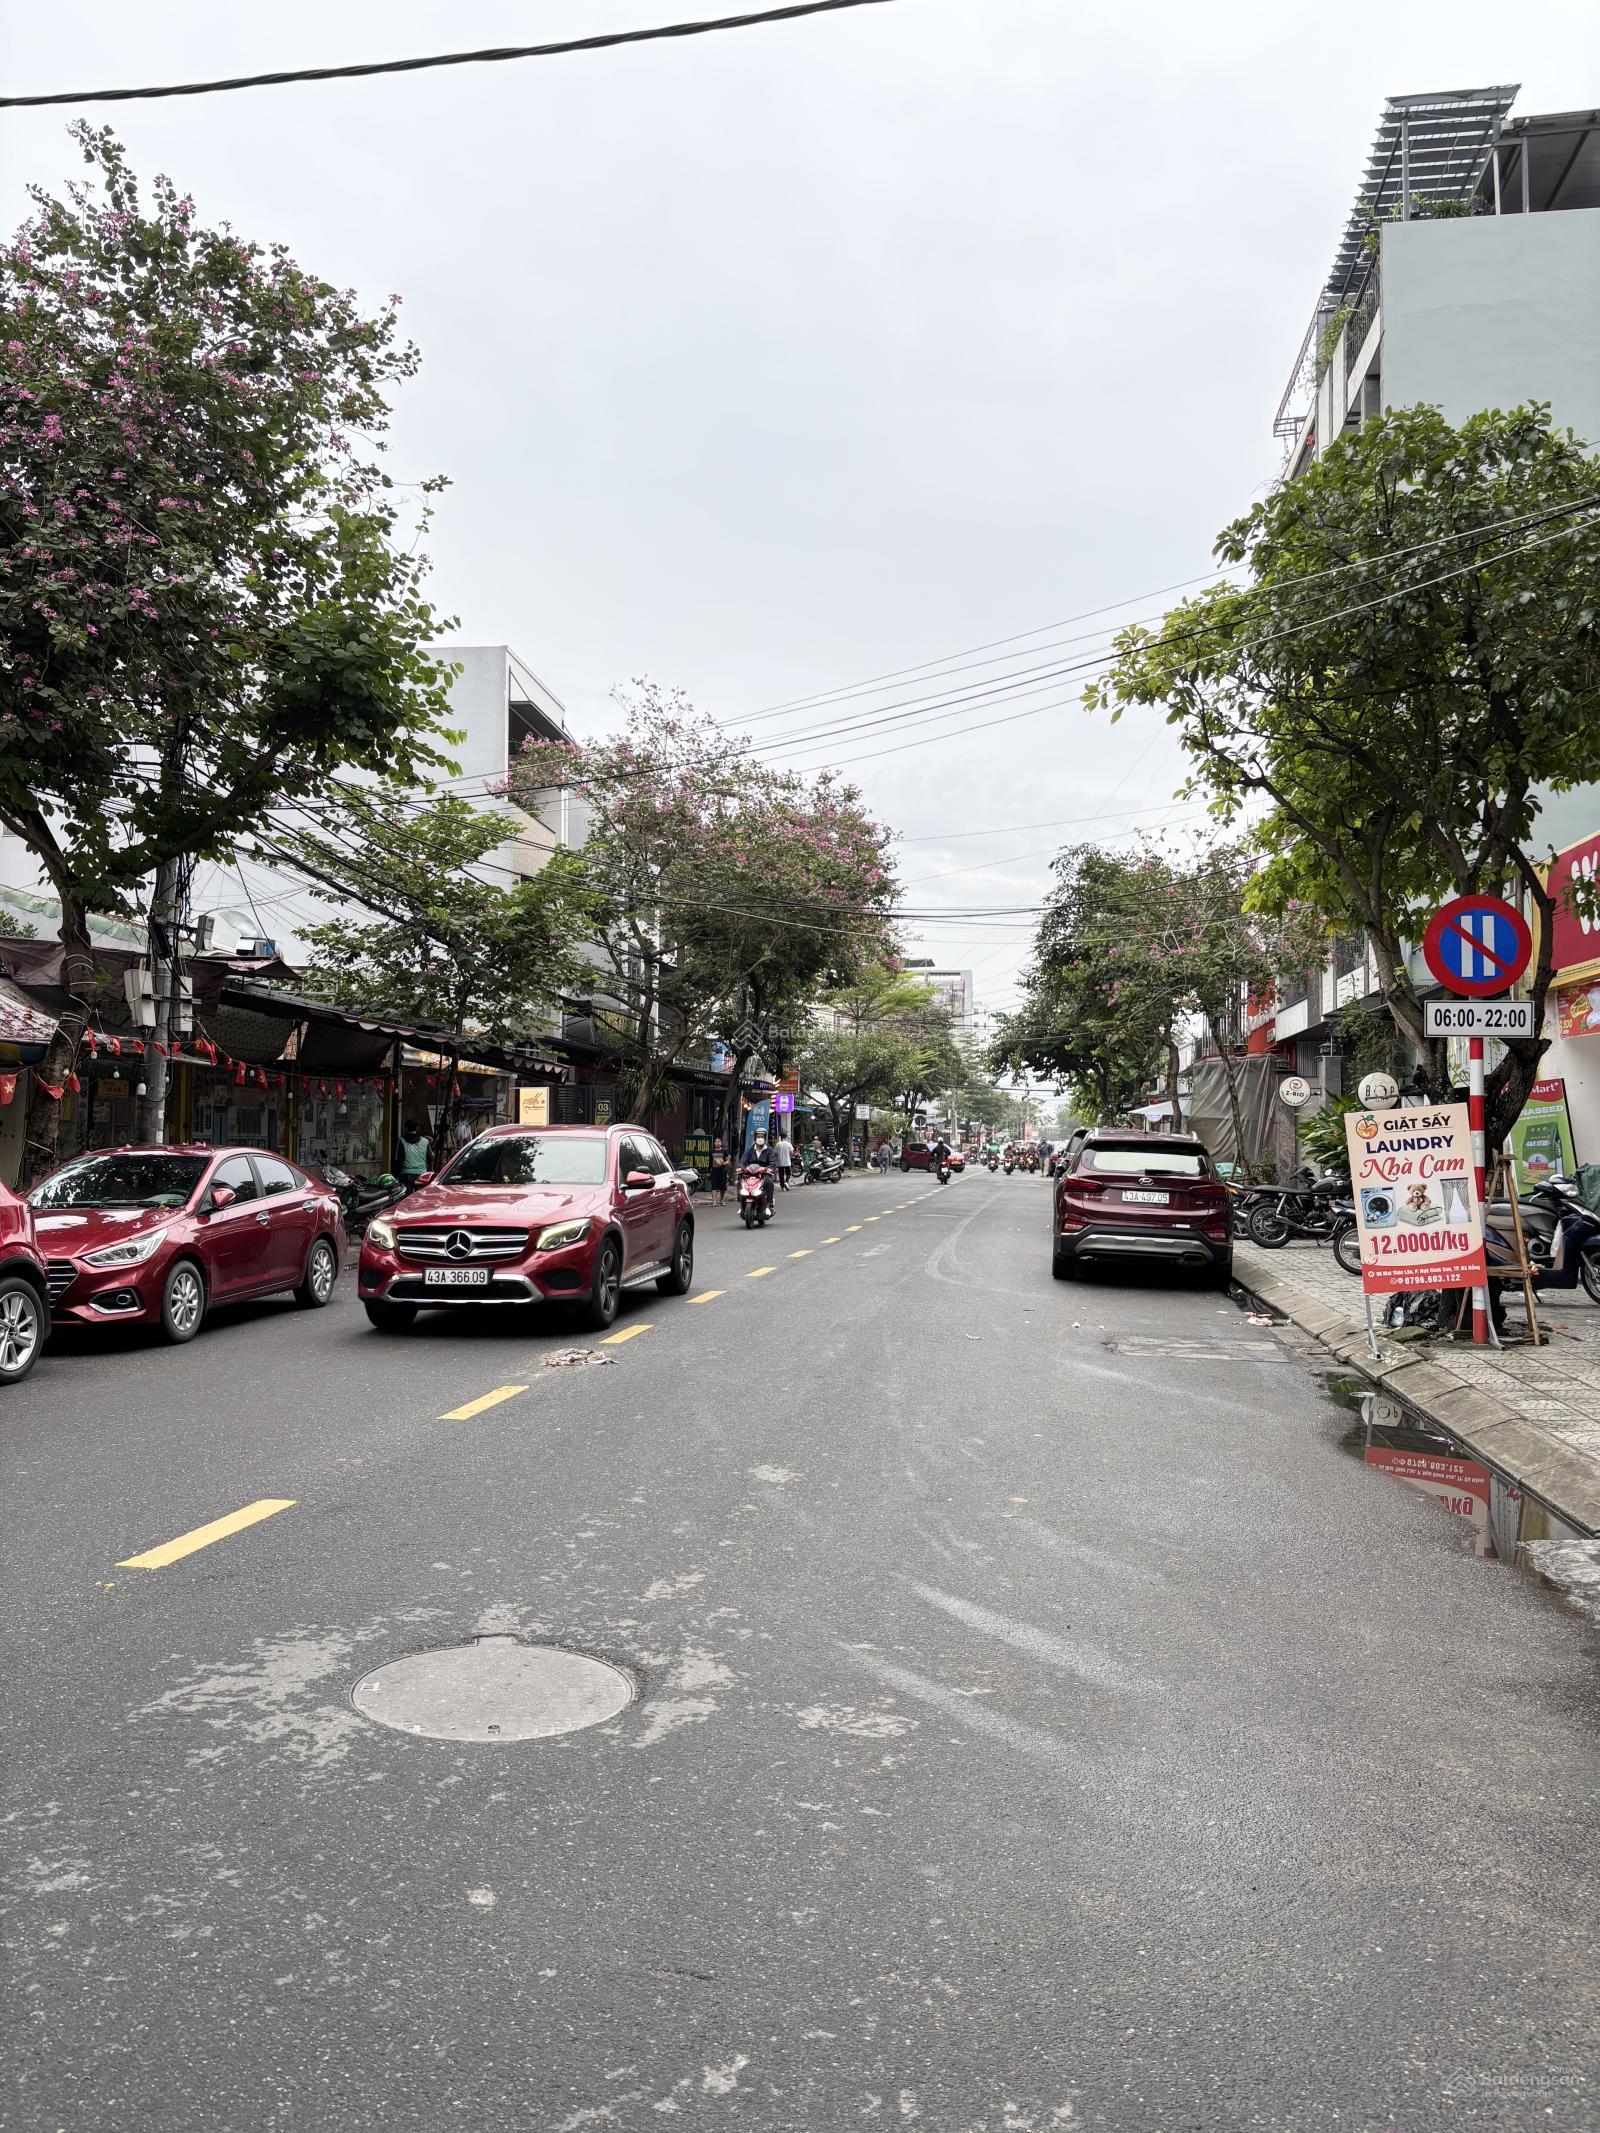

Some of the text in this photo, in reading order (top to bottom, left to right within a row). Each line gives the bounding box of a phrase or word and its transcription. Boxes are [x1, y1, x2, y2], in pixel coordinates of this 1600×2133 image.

[597, 1102, 609, 1112] 03
[1520, 1104, 1564, 1117] NASEED
[1383, 1112, 1451, 1132] GIẶT SẤY
[1365, 1135, 1454, 1154] LAUNDRY
[1359, 1154, 1465, 1183] Nhà Cam
[1370, 1230, 1469, 1255] 12.000đ/kg
[427, 1270, 486, 1283] 43A-366.09
